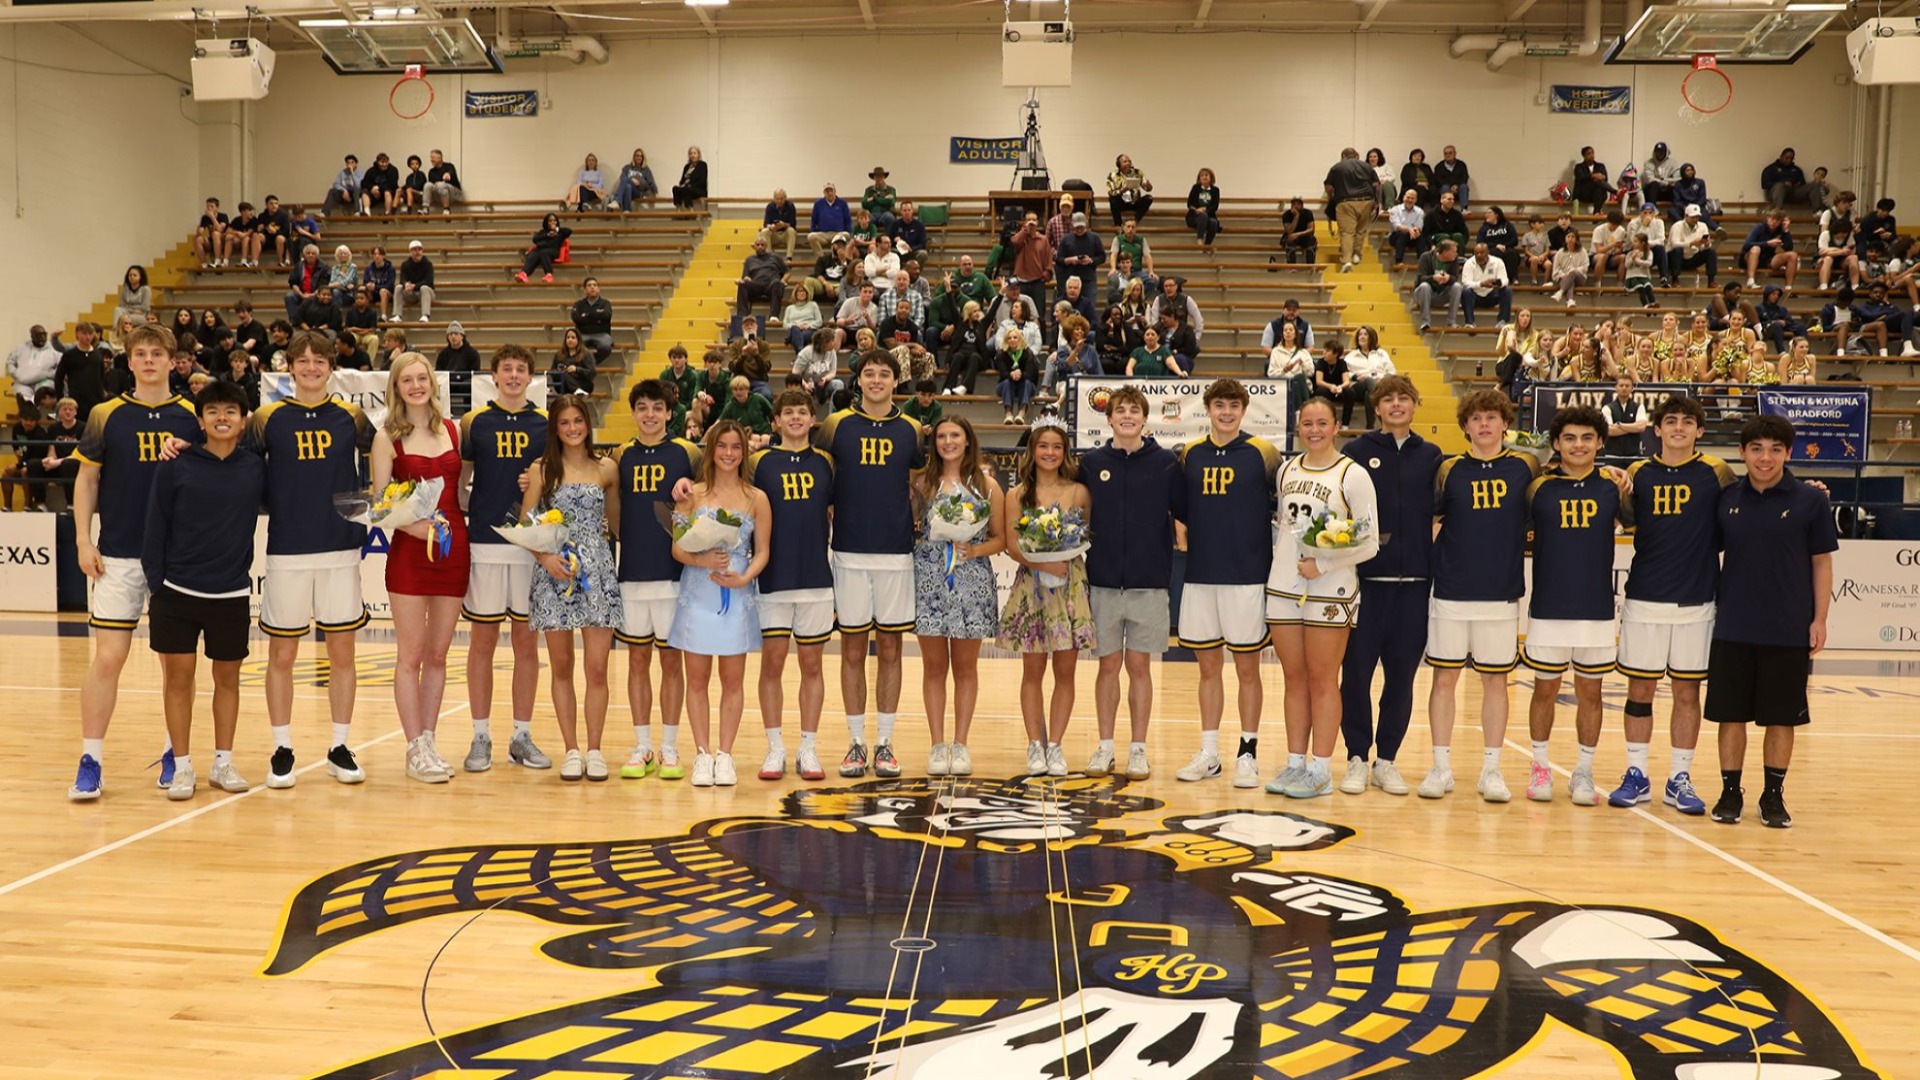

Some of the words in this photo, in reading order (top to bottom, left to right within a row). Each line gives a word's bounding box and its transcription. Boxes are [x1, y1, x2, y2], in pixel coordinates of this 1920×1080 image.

[477, 94, 525, 104] VISITOR
[1571, 89, 1610, 98] HOME
[469, 104, 533, 114] STUDENTS
[1555, 100, 1626, 109] OVERFLOW
[956, 140, 1022, 149] VISITOR
[958, 150, 1019, 159] ADULTS
[1172, 384, 1200, 395] YOU
[1555, 391, 1605, 409] LADY
[1768, 396, 1805, 405] STEVEN
[1807, 397, 1814, 405] &
[1816, 397, 1859, 406] KATRINA
[1788, 410, 1842, 418] BRADFORD
[294, 429, 333, 460] HP
[495, 431, 530, 458] HP
[860, 437, 893, 465] HP
[632, 464, 666, 493] HP
[780, 471, 815, 500] HP
[1202, 467, 1235, 495] HP
[1312, 482, 1333, 504] PARK
[1470, 478, 1508, 510] HP
[1652, 484, 1691, 515] HP
[1559, 499, 1599, 529] HP
[0, 546, 50, 565] EXAS
[1855, 584, 1908, 595] VANESSA
[1114, 953, 1228, 994] HP
